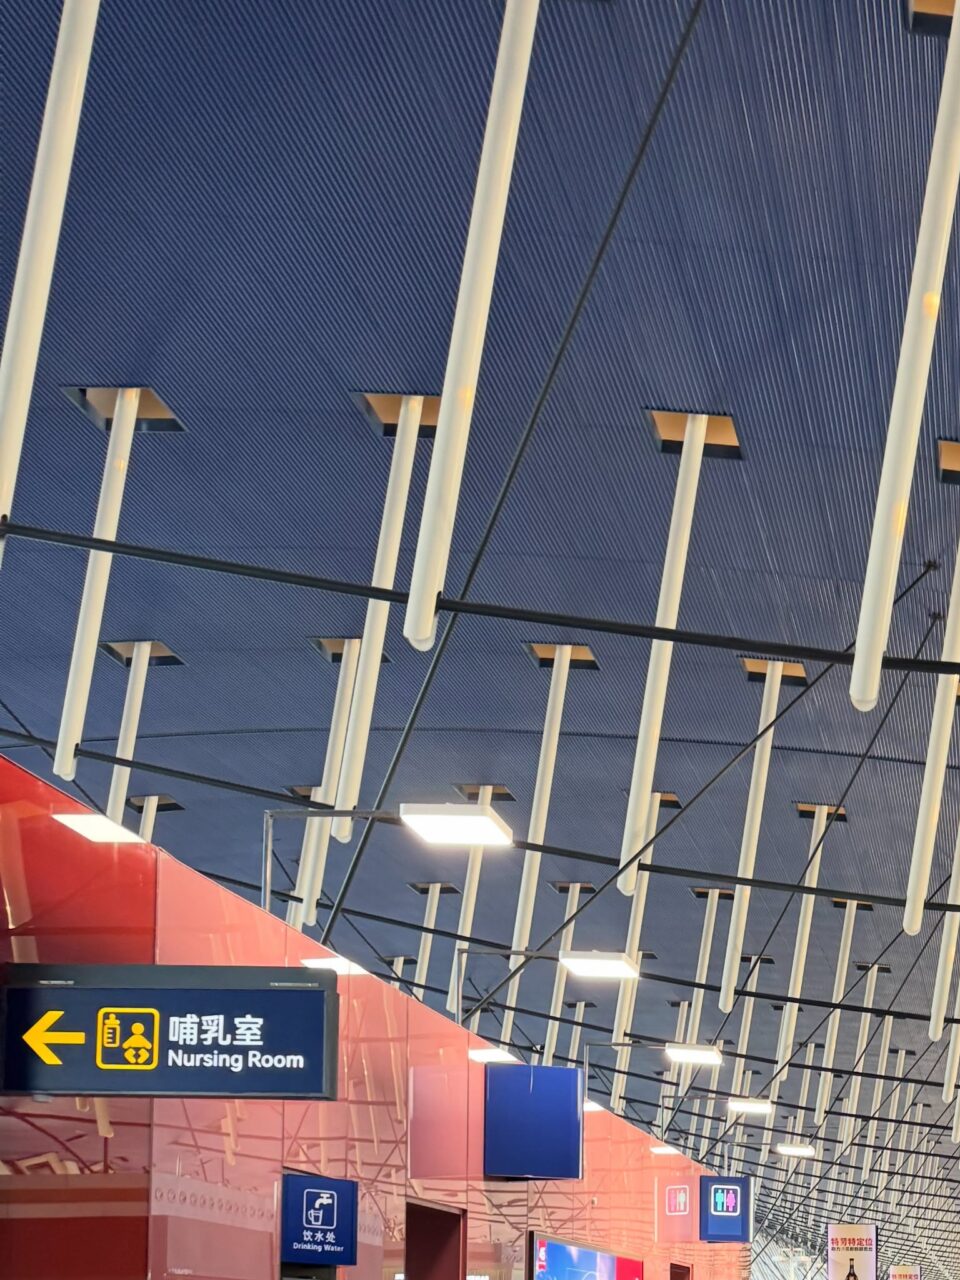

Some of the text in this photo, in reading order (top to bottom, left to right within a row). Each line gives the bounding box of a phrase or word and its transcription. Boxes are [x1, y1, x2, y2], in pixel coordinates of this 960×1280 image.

[168, 1014, 264, 1046] 哺乳室
[167, 1050, 305, 1072] Nursing Room
[302, 1229, 336, 1243] 饮水处
[292, 1242, 345, 1252] Drinking Water
